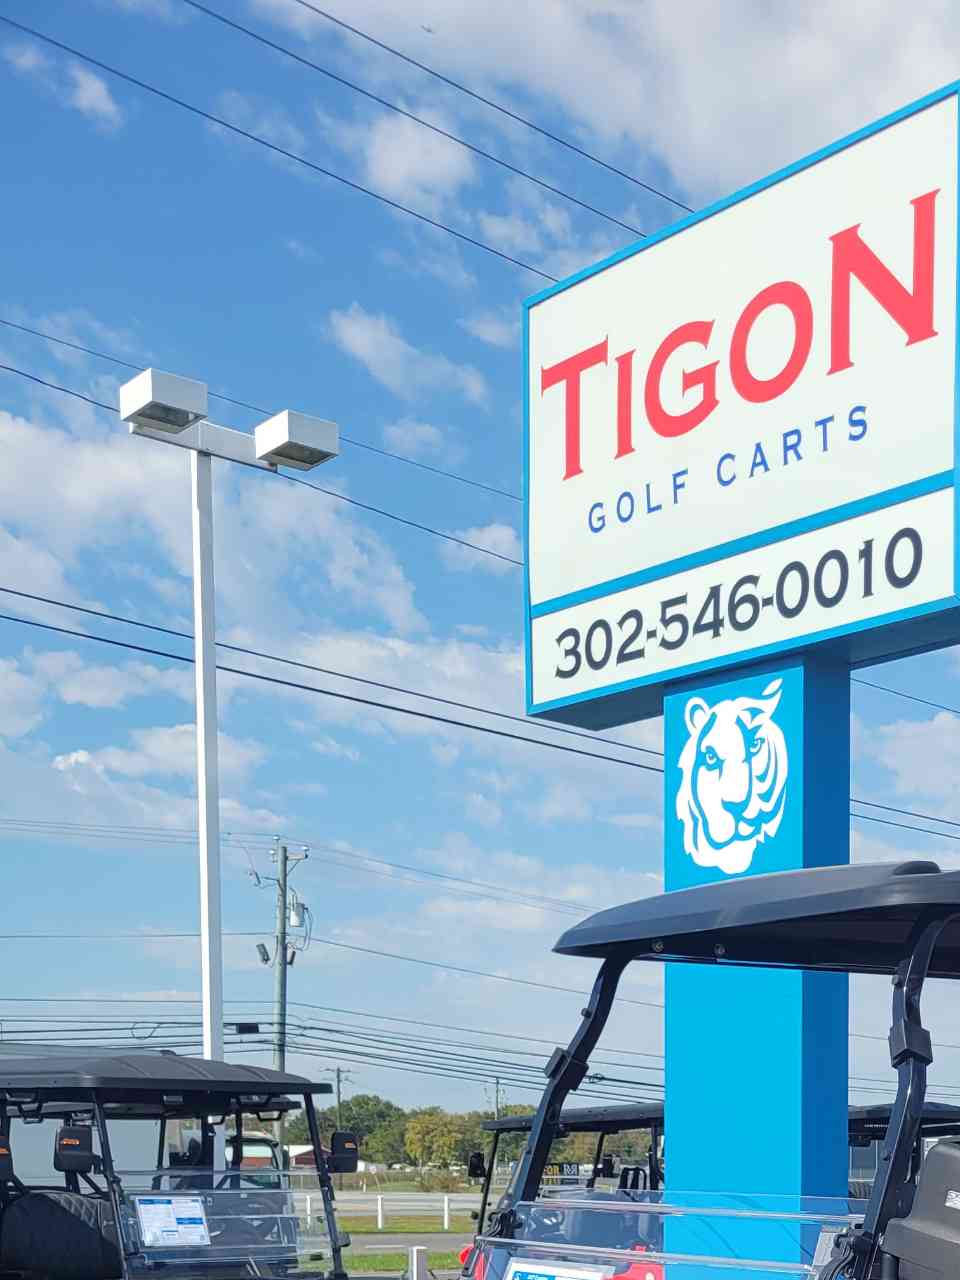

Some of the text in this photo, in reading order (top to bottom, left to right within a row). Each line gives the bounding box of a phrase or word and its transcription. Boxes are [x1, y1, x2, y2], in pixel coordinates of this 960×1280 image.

[541, 189, 941, 481] TIGON
[588, 405, 868, 534] GOLF CARTS
[555, 527, 923, 679] 302-546-0010
